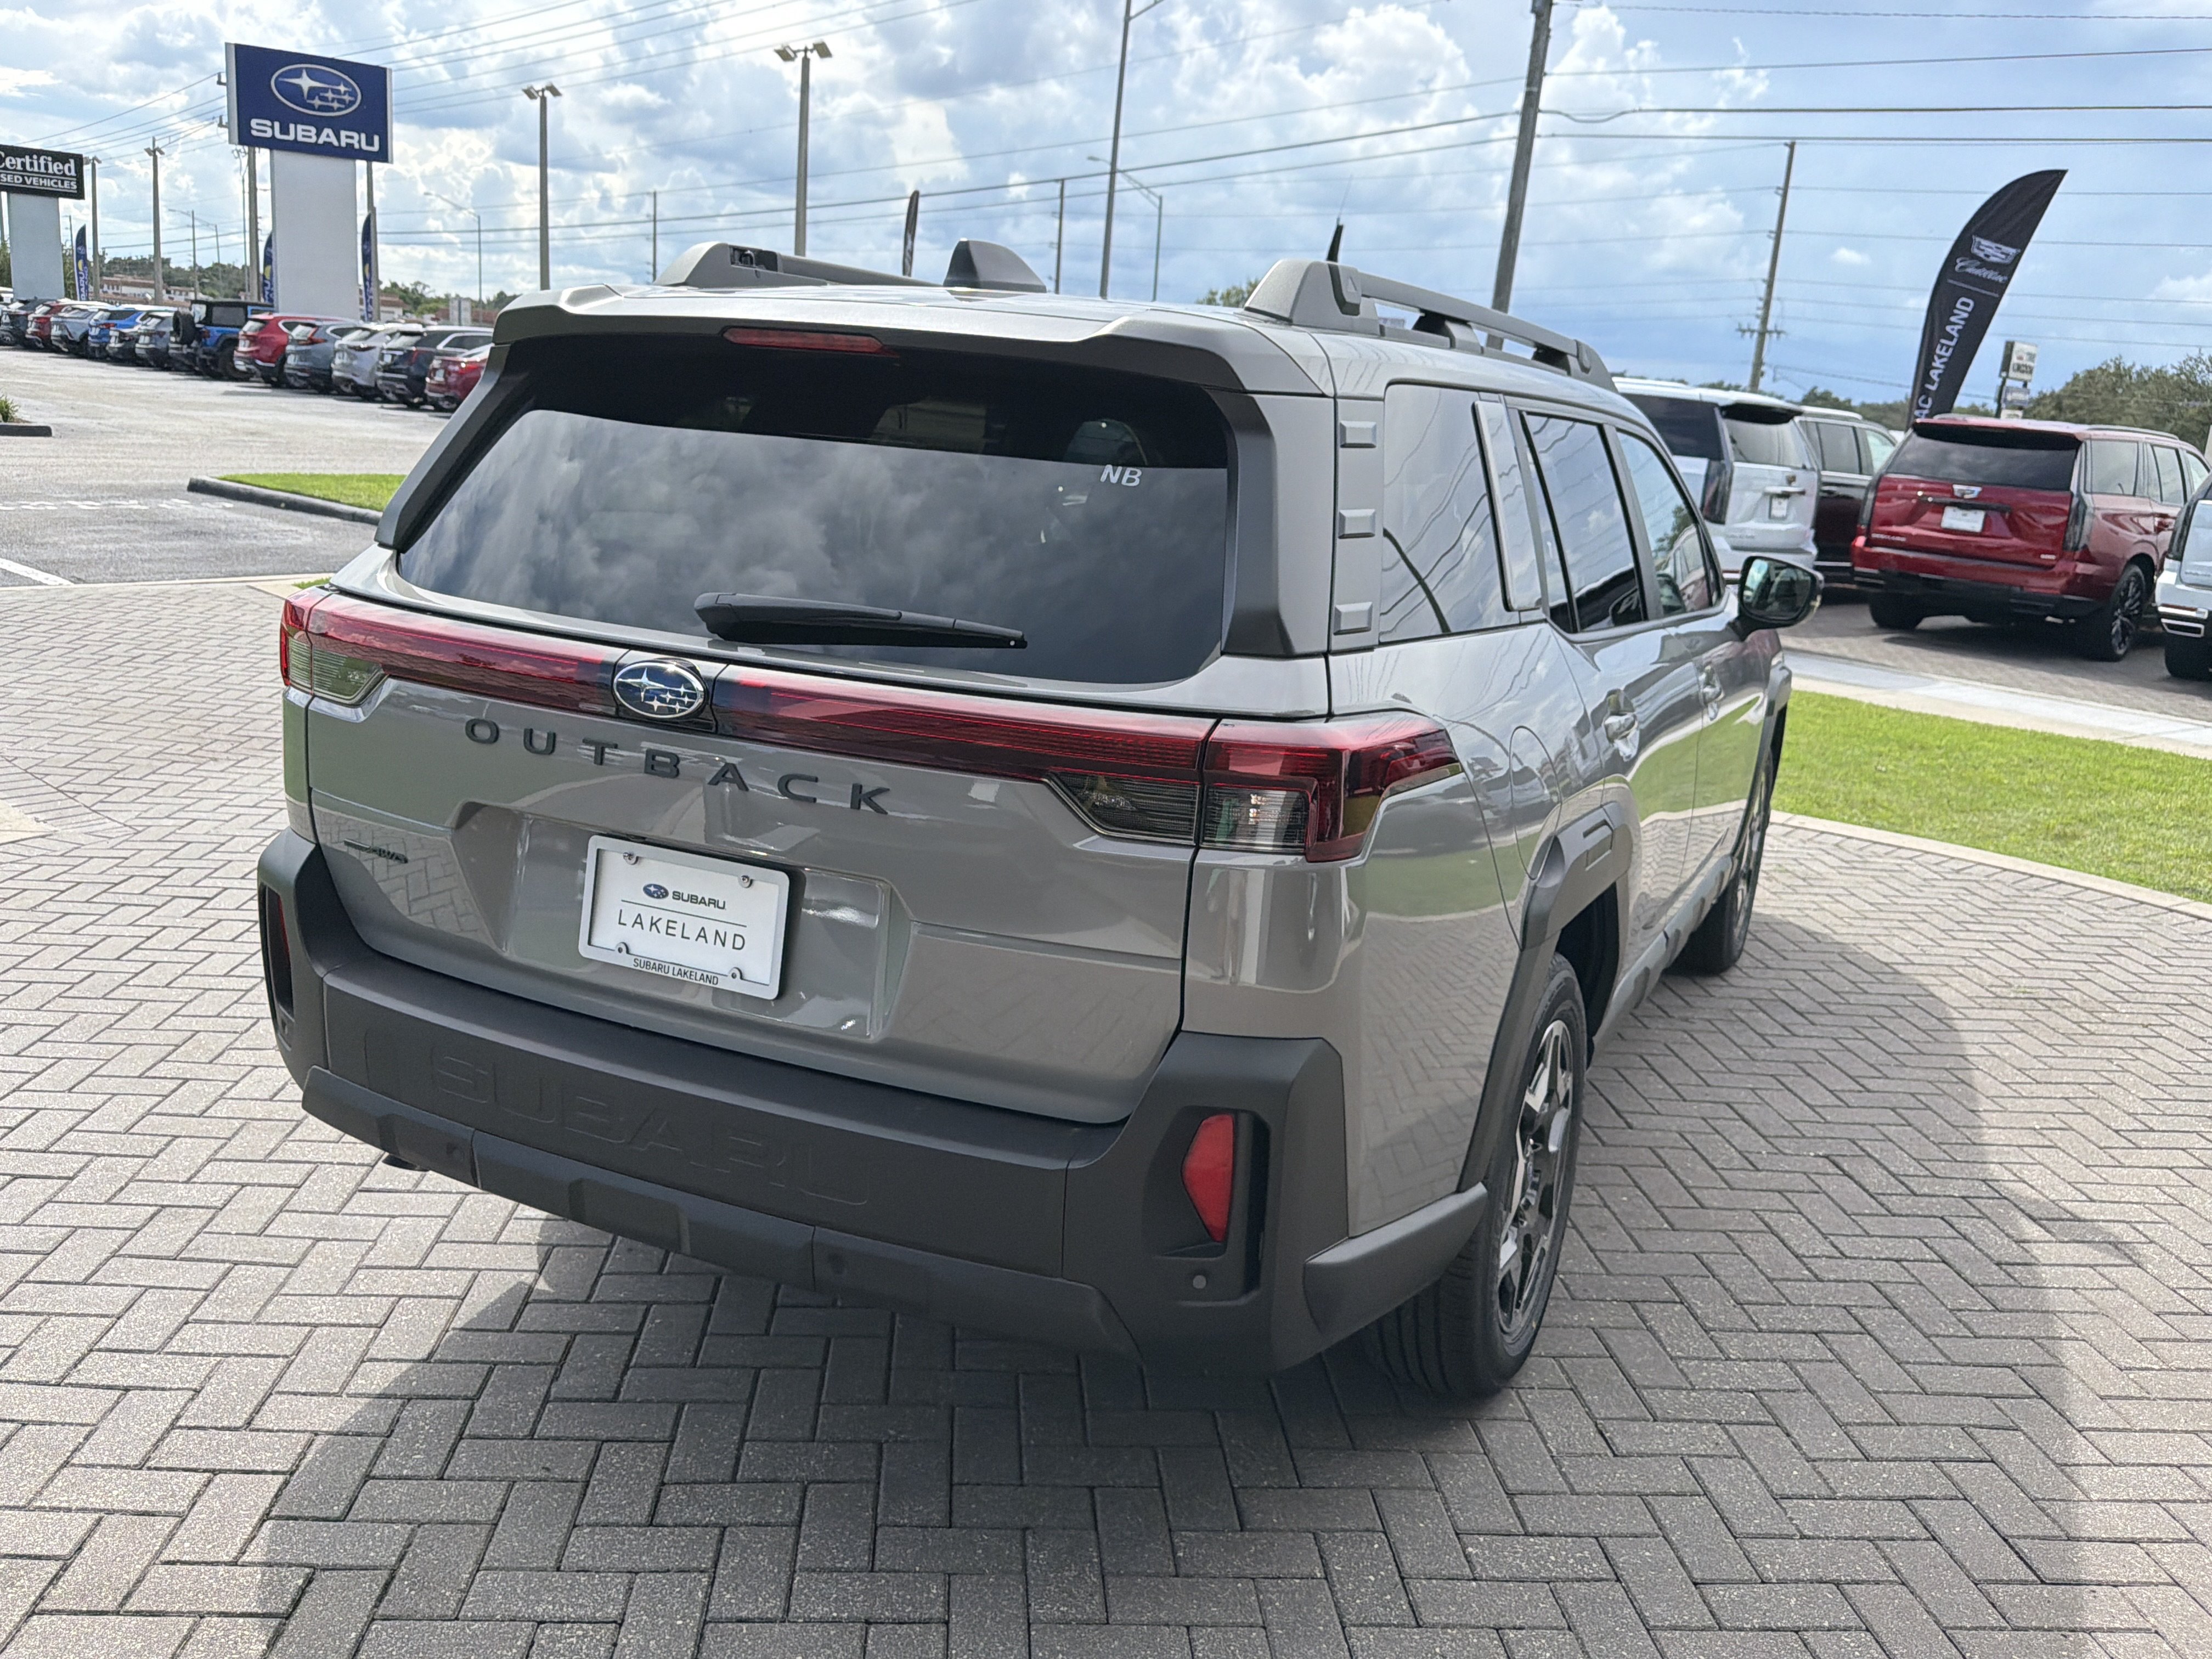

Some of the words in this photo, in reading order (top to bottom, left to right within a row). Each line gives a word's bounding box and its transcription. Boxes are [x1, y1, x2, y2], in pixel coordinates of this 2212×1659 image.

[250, 118, 380, 152] SUBARU
[0, 173, 23, 184] SED
[24, 176, 77, 190] VEHICLES
[1924, 296, 1975, 391] LAKELAND
[1100, 464, 1142, 487] NB
[465, 718, 890, 815] OUTBACK
[672, 890, 726, 910] SUBARU
[618, 909, 746, 951] LAKELAND
[633, 957, 670, 974] SUBARU
[672, 966, 719, 986] LAKELAND
